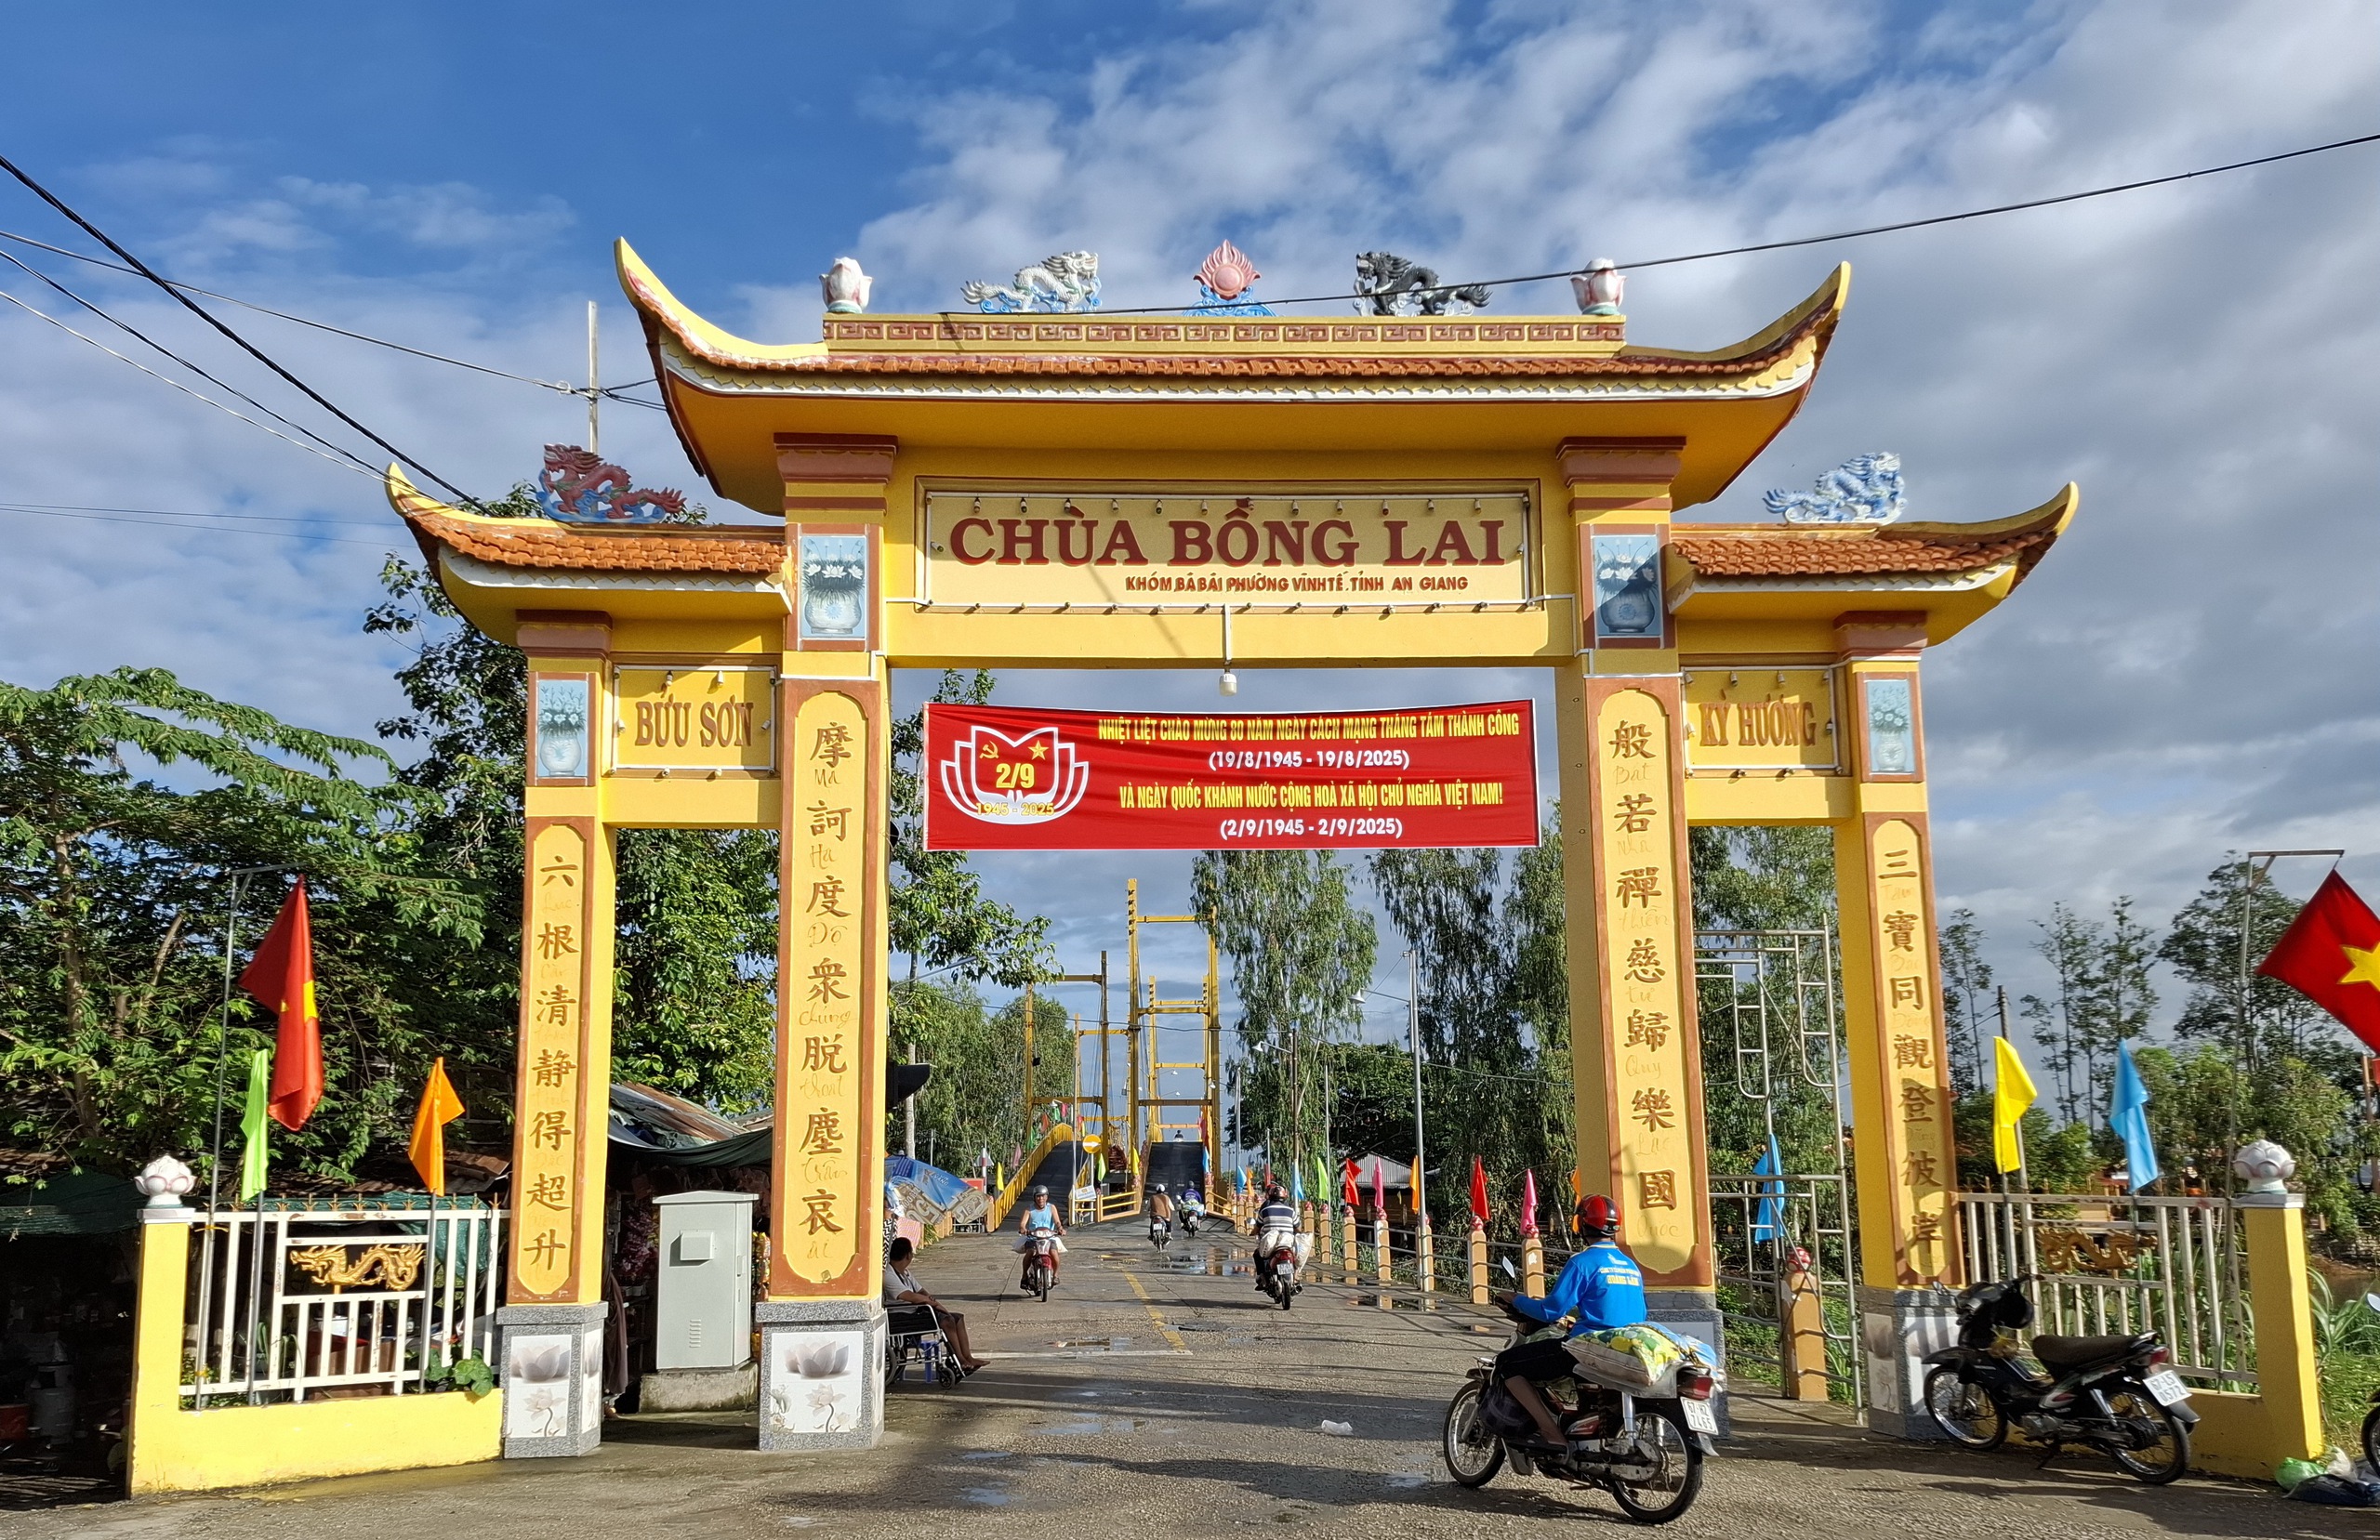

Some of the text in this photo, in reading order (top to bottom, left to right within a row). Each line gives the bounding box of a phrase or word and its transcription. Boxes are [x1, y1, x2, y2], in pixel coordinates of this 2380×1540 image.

[950, 498, 1505, 567] CHÙA BỒNG LAI
[1126, 571, 1171, 591] KHÓM
[1350, 571, 1383, 591] TỈNH
[1392, 576, 1412, 591] AN
[1419, 576, 1468, 591] GIANG
[700, 694, 753, 747] SƠN
[1099, 709, 1520, 744] NHIỆT LIỆT CHÀO MỪNG 80 NĂM NGÀY CÁCH MẠNG THÁNG TÁM THÀNH CÔNG
[1699, 689, 1817, 746] KỲ HƯƠNG
[1209, 751, 1302, 771] (19/8/1945
[1316, 749, 1409, 770] 19/8/2025)
[996, 762, 1035, 789] 2/9
[976, 802, 1009, 816] 1945
[1021, 802, 1055, 816] 2025
[1119, 777, 1503, 811] VÀ NGÀY QUỐC KHÁNH NƯỚC CỘNG HOÀ XÃ HỘI CHỦ NGHĨA VIỆT NAM!
[1220, 819, 1304, 840] (2/9/1945
[1318, 818, 1403, 839] 2/9/2025)
